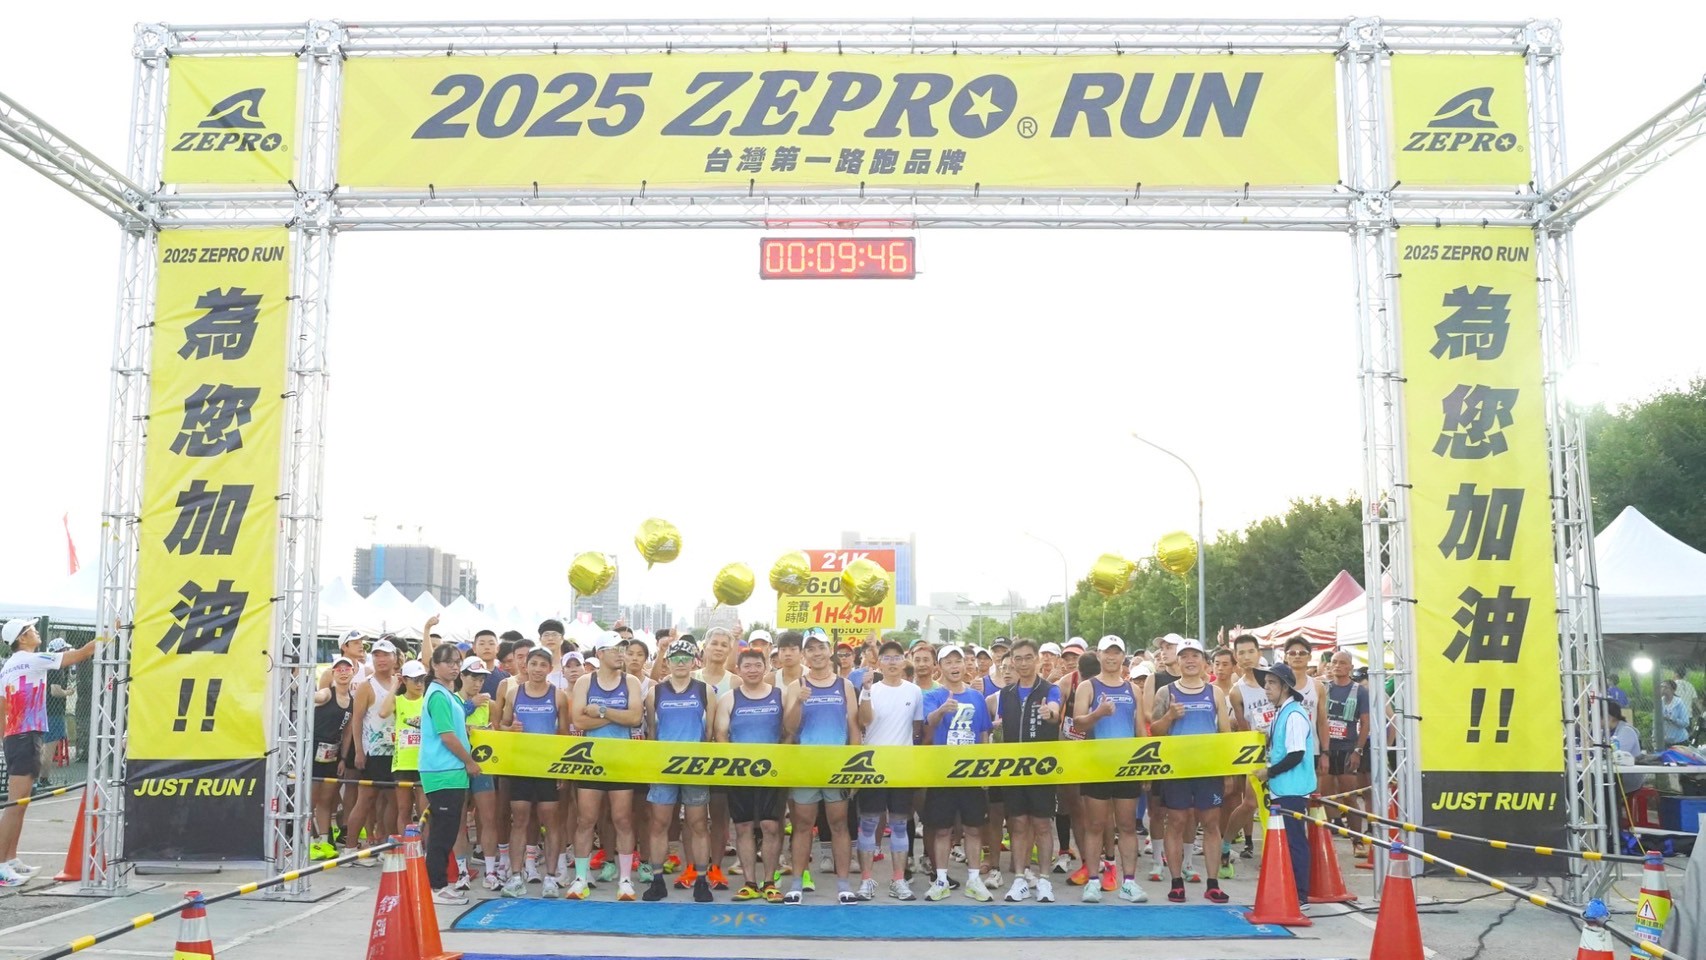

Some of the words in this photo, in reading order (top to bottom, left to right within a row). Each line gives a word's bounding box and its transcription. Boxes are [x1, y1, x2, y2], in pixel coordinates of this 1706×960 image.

[411, 72, 652, 139] 2025
[661, 70, 1018, 138] ZEPRO
[1050, 72, 1263, 139] RUN
[172, 132, 282, 152] ZEPRO
[1402, 132, 1517, 152] ZEPRO
[704, 146, 966, 175] 台灣第一路跑品牌
[163, 247, 197, 263] 2025
[199, 247, 249, 263] ZEPRO
[252, 246, 285, 262] RUN
[765, 242, 908, 273] 00:09:46
[1404, 245, 1439, 260] 2025
[1441, 245, 1493, 261] ZEPRO
[1496, 246, 1529, 262] RUN
[785, 612, 808, 623] 時間
[812, 601, 884, 624] 1H45M
[548, 760, 603, 776] ZEPRO
[661, 756, 773, 777] ZEPRO
[946, 757, 1059, 778] ZEPRO
[1115, 764, 1171, 778] ZEPRO
[134, 778, 194, 797] JUST
[195, 778, 244, 797] RUN
[247, 778, 257, 797] !
[829, 770, 885, 785] ZEPRO
[1431, 791, 1492, 811] JUST
[1494, 792, 1545, 811] RUN
[1548, 792, 1556, 811] !
